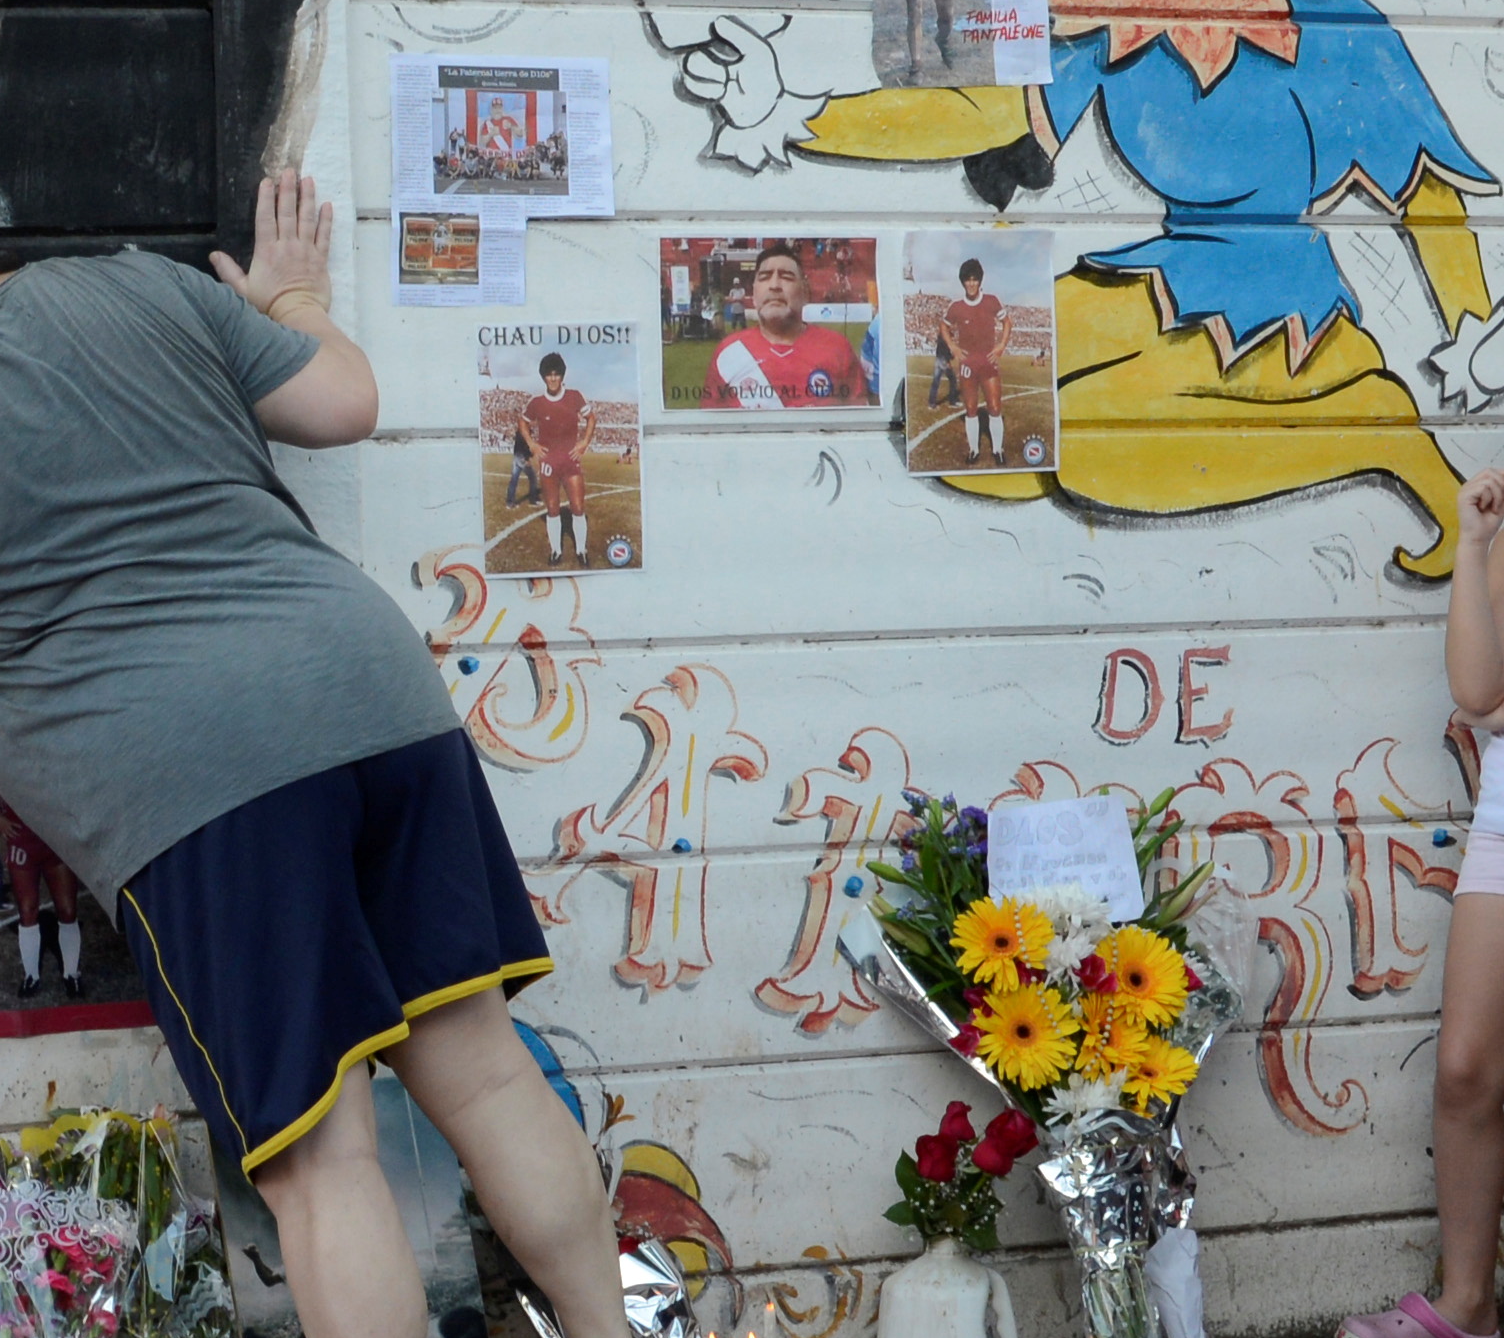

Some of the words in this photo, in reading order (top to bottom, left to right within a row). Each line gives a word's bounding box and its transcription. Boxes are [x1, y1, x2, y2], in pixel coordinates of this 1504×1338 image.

[478, 327, 543, 347] CHAU
[959, 364, 972, 379] 10
[717, 384, 774, 399] VOLVIO
[778, 384, 802, 399] AL
[1094, 644, 1233, 747] DE
[10, 845, 28, 866] 10
